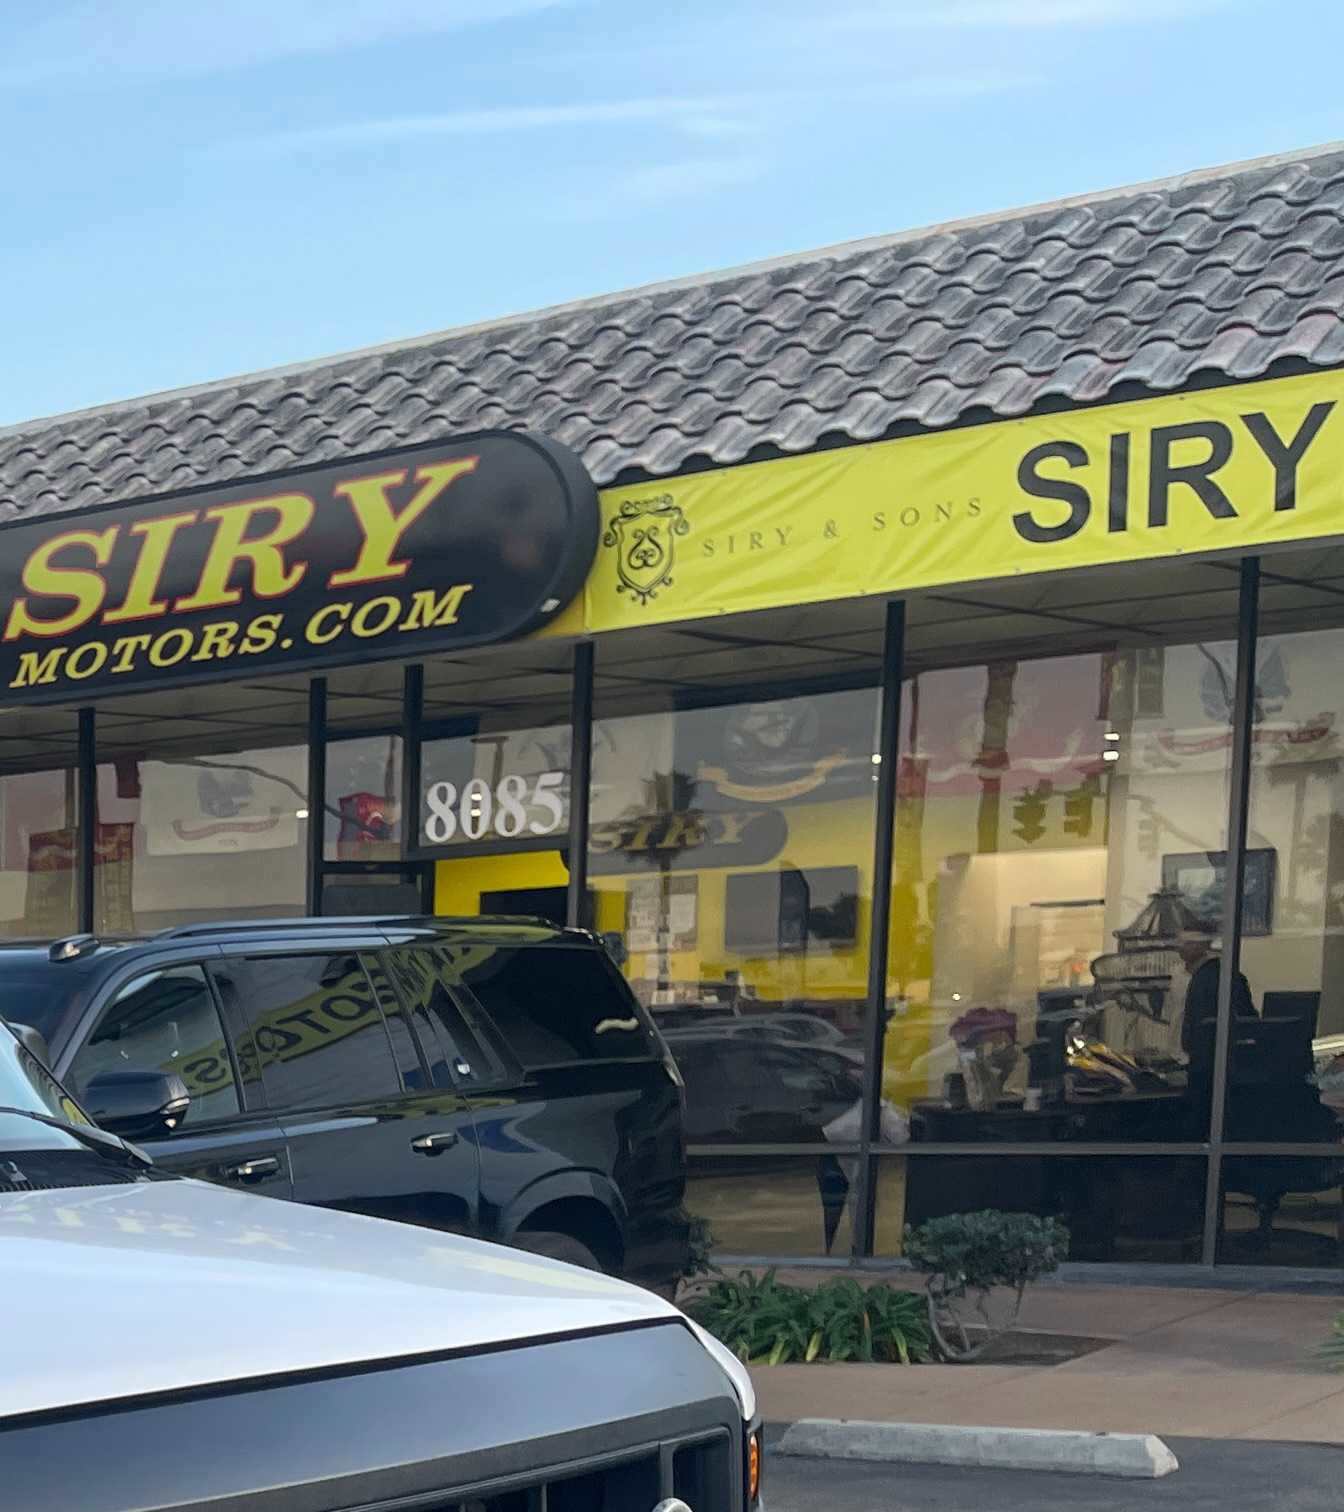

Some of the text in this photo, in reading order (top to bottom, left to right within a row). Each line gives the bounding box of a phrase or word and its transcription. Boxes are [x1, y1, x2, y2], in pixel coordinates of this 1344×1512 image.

[1011, 400, 1340, 545] SIRY
[3, 454, 480, 643] SIRY
[703, 497, 982, 557] SIRY & SONS
[8, 584, 473, 690] MOTORS.COM
[424, 771, 566, 844] 8085
